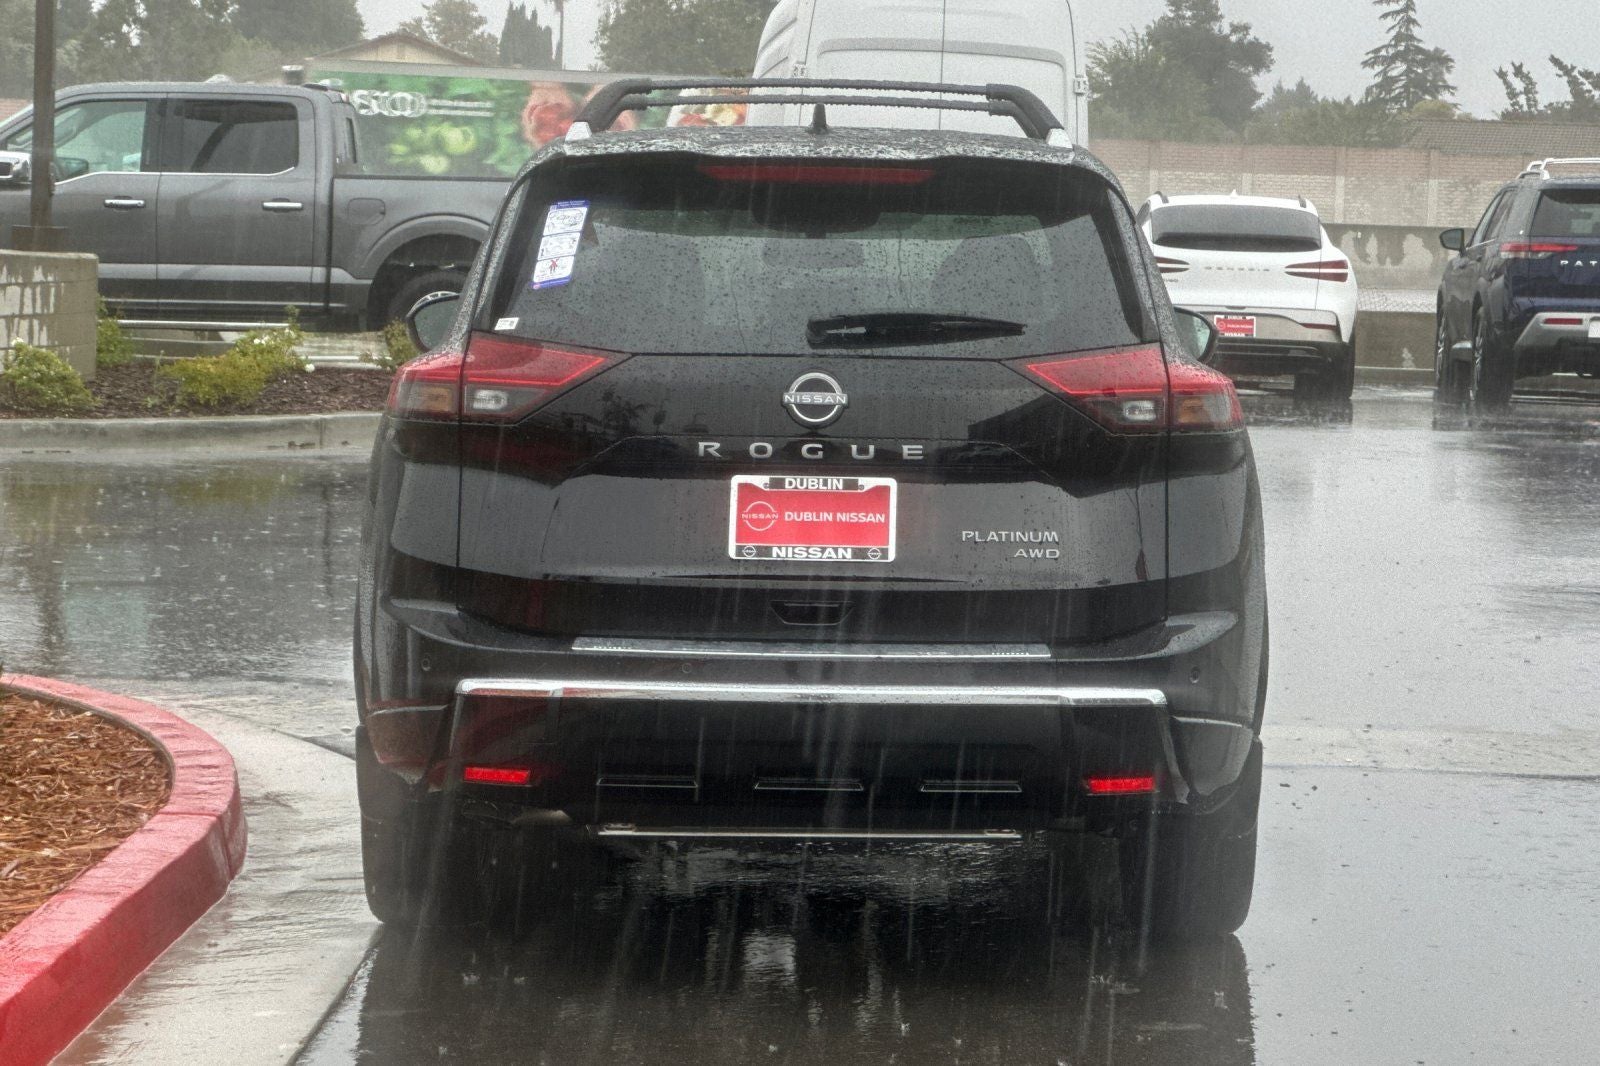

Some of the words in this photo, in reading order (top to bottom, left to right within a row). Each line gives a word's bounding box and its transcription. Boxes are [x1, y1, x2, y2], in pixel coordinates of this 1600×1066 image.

[784, 395, 846, 403] NISSAN
[698, 441, 925, 460] ROGUE
[785, 478, 843, 490] DUBLIN
[784, 511, 833, 522] DUBLIN
[836, 512, 885, 523] NISSAN
[962, 530, 1059, 542] PLATINUM
[771, 546, 852, 559] NISSAN
[1014, 548, 1060, 558] AWD
